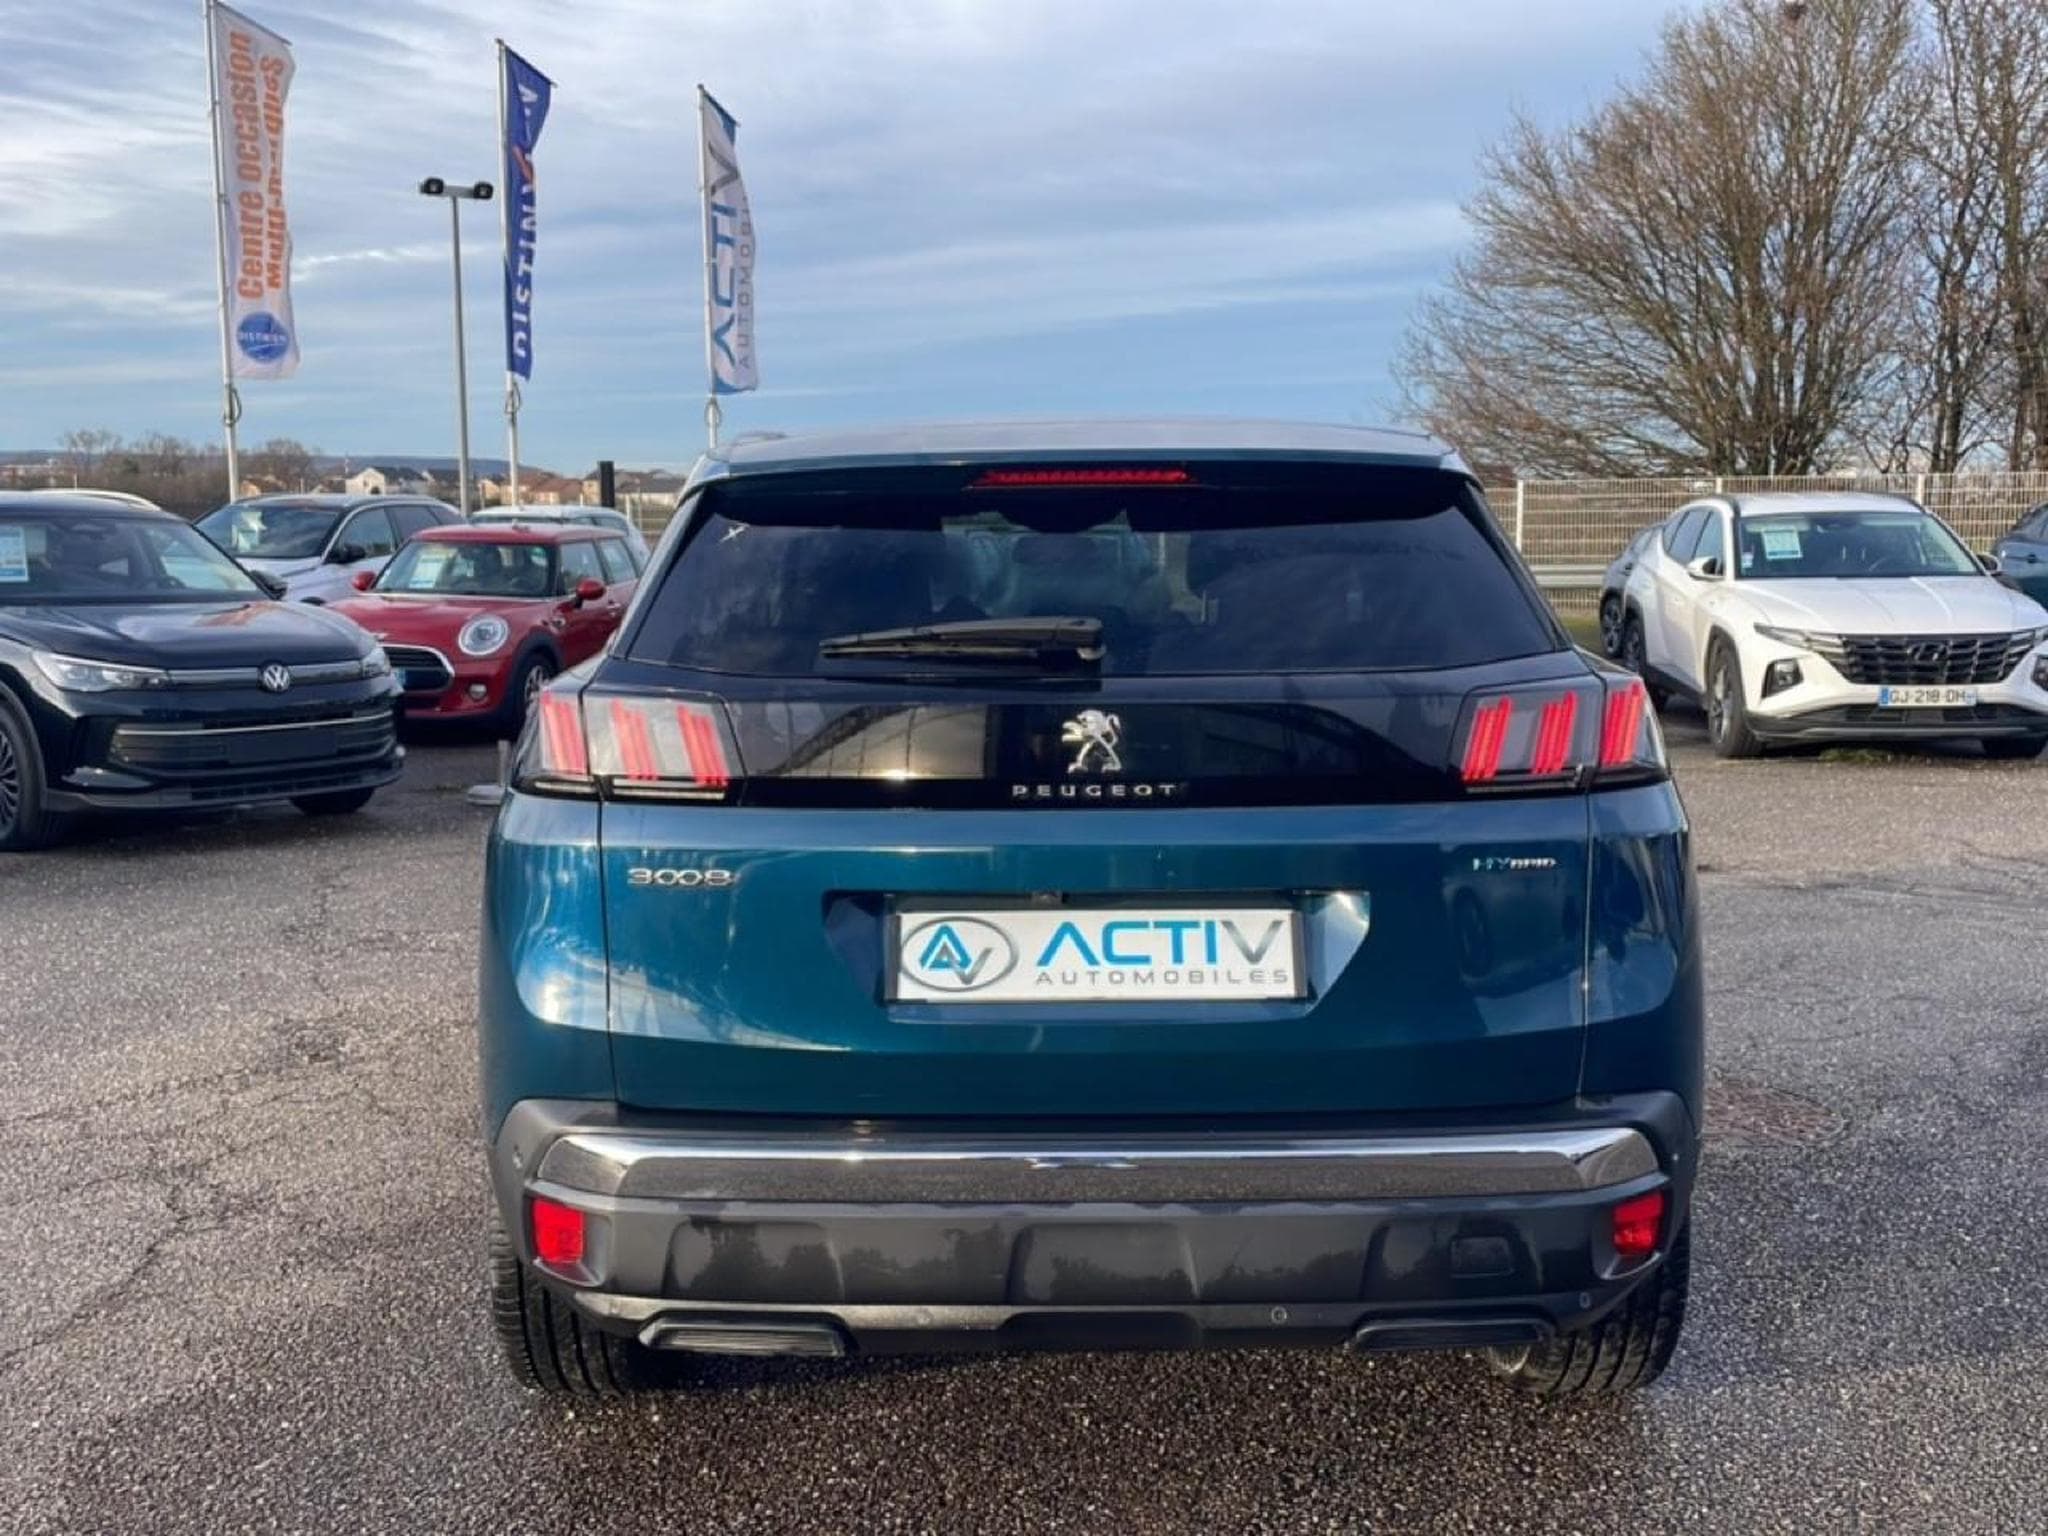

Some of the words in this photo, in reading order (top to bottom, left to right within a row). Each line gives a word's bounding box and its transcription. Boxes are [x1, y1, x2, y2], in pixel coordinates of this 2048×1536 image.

[229, 31, 263, 183] occasion
[237, 191, 264, 299] Centre
[708, 140, 740, 368] ACTIV
[1012, 784, 1176, 797] PEUGEOT
[626, 867, 734, 887] 3008
[1036, 919, 1284, 967] ACTIV
[1035, 969, 1289, 985] AUTOMOBILES
